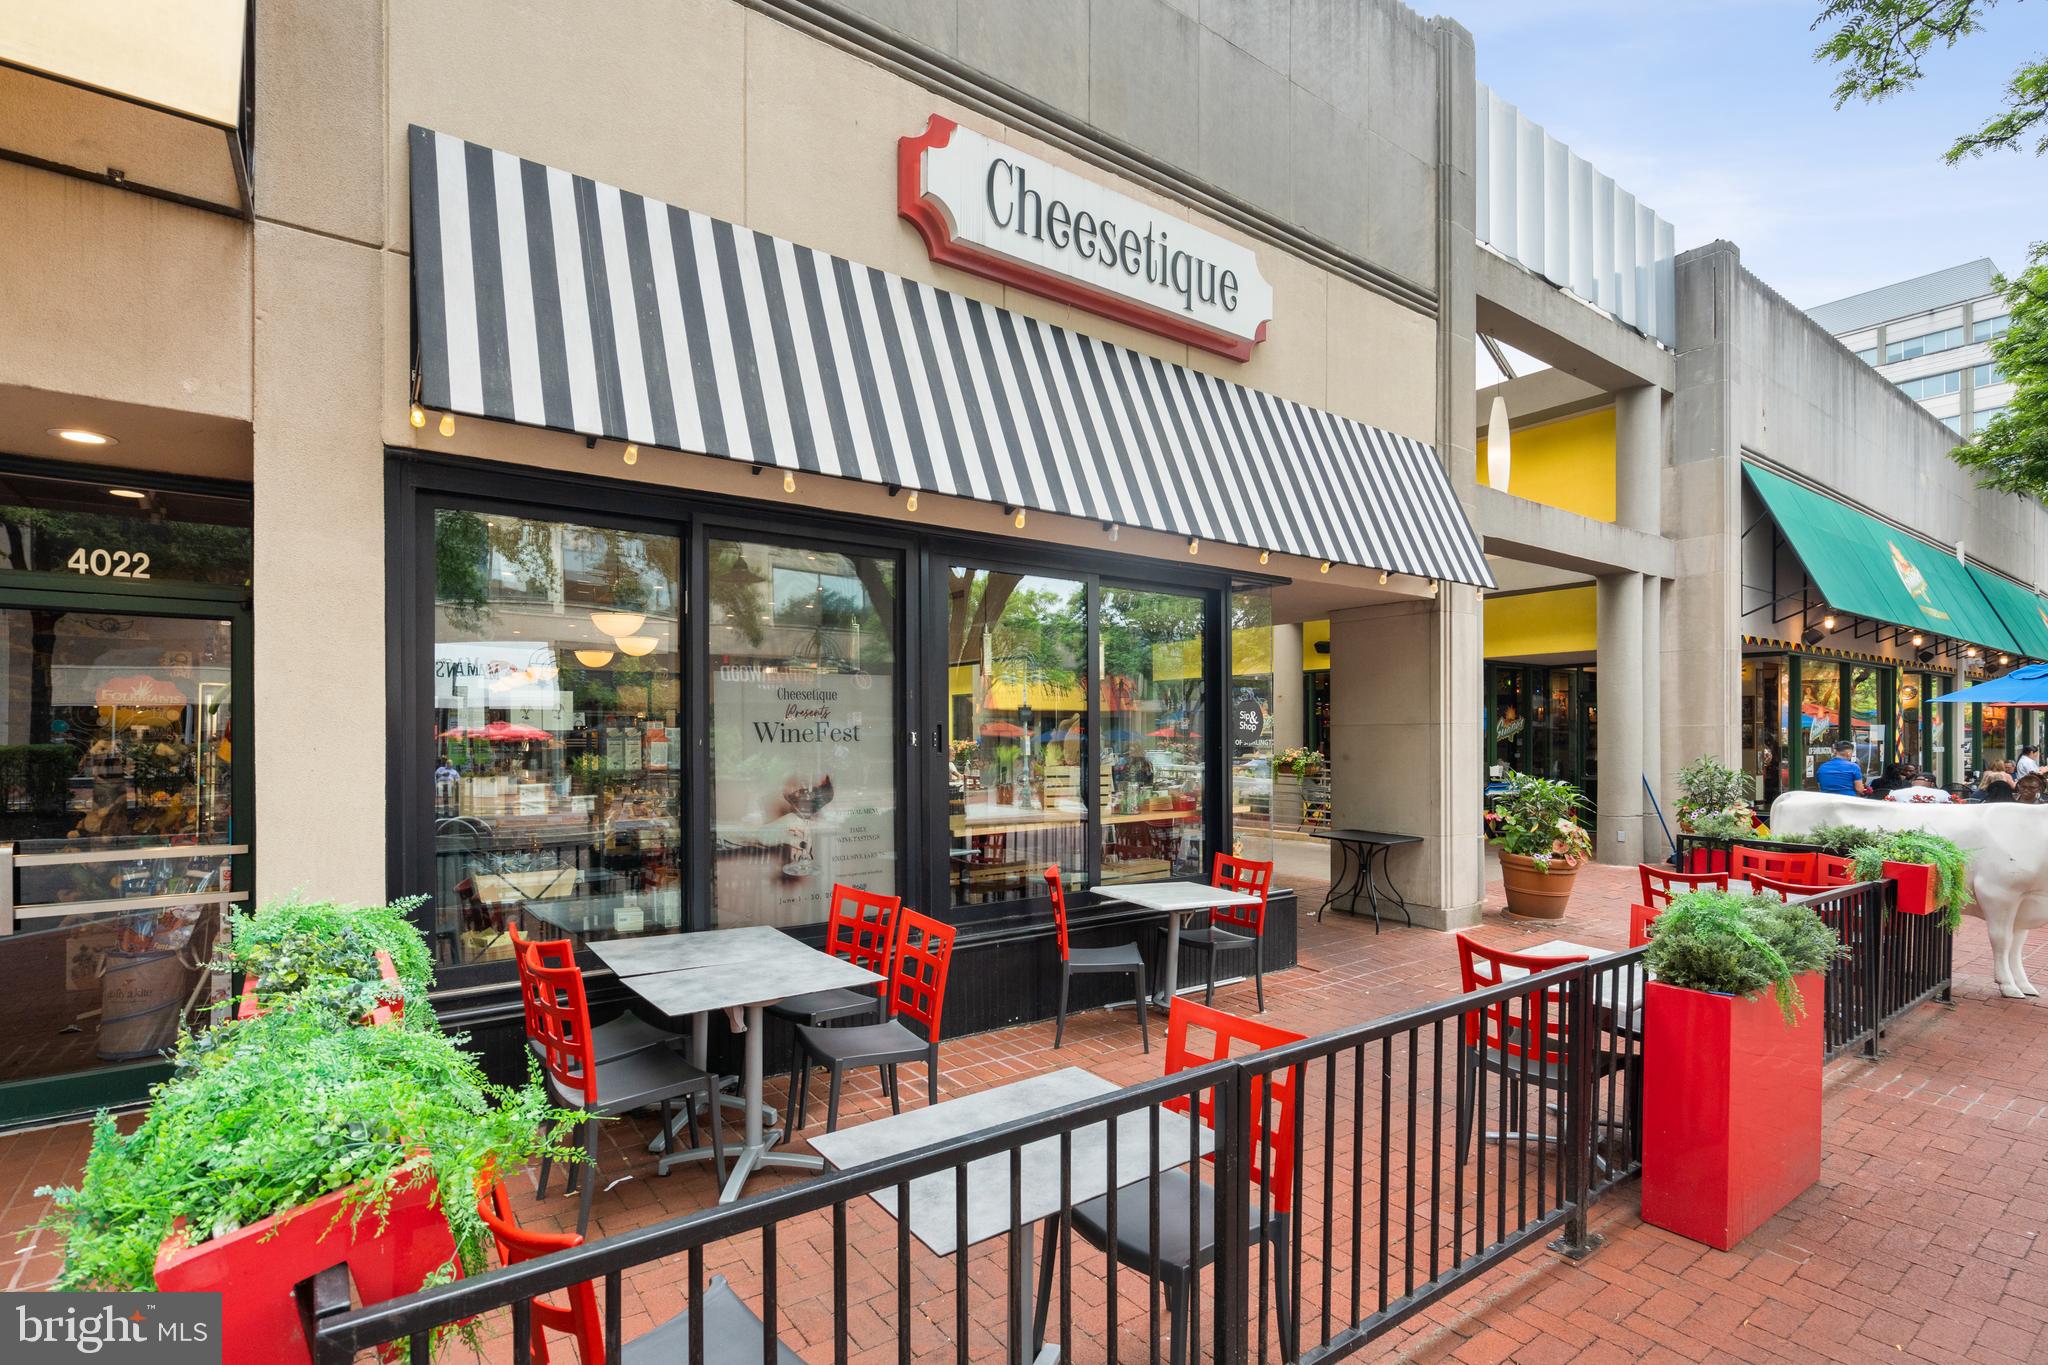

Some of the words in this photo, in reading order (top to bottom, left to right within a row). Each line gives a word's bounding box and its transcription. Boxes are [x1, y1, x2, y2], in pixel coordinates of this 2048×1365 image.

[987, 158, 1238, 312] Cheesetique
[67, 547, 150, 579] 4022
[777, 687, 838, 702] Cheesetique
[784, 704, 832, 720] Presents
[1239, 711, 1250, 721] Sip
[1250, 711, 1259, 724] &
[753, 721, 863, 743] WineFest
[1239, 721, 1257, 732] Shop
